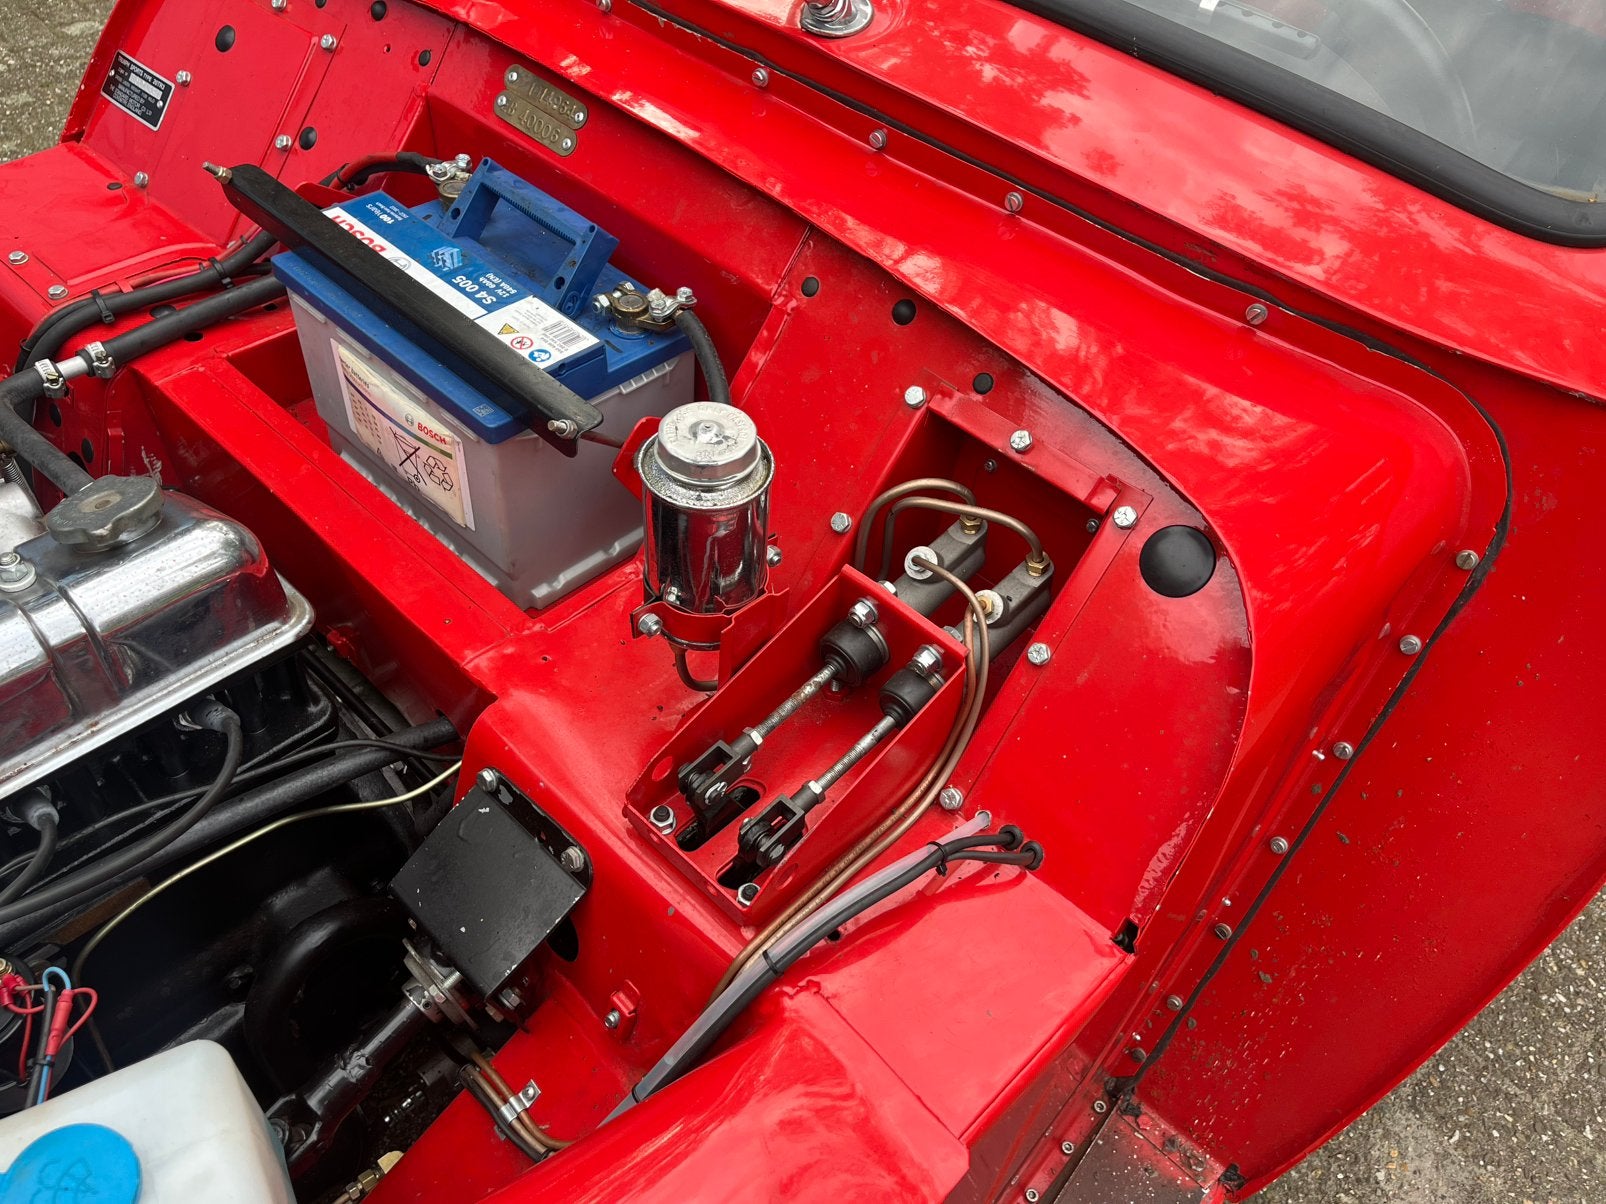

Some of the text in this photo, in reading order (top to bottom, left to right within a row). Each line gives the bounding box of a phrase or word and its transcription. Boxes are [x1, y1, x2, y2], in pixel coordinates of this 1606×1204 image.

[130, 64, 143, 76] SPORTS
[143, 72, 152, 82] TYPE
[519, 108, 561, 143] 40006
[379, 214, 394, 225] 100
[451, 275, 496, 305] S4 005
[479, 276, 510, 298] 12V 60Ah
[500, 282, 518, 294] 540A
[417, 421, 447, 445] BOSCH
